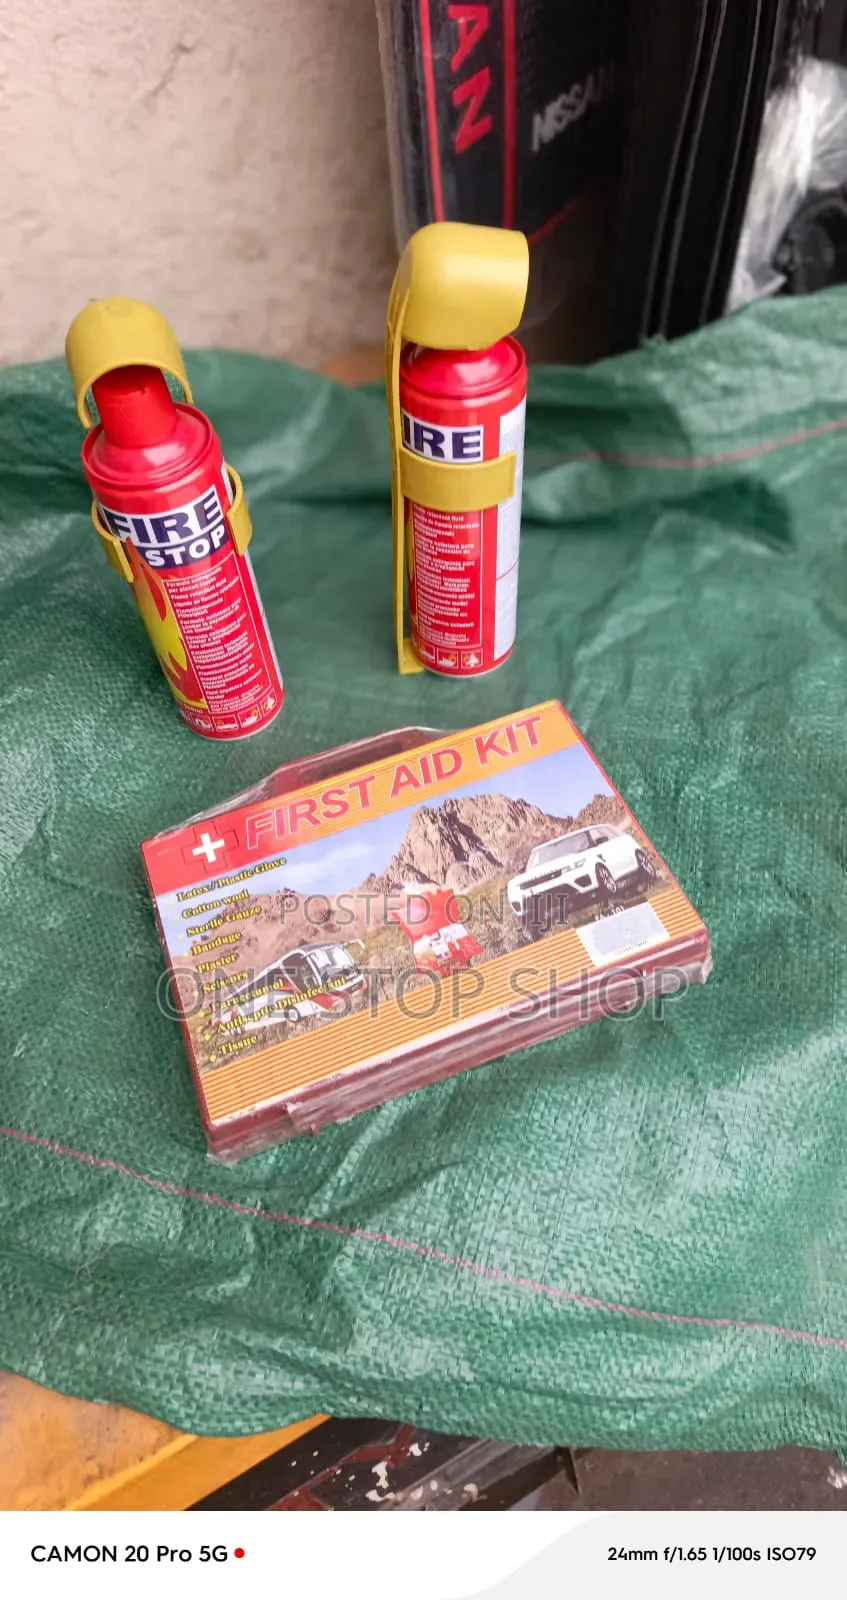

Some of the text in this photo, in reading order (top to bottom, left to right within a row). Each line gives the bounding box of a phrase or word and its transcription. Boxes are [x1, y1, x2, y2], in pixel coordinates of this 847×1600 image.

[102, 489, 222, 544] FIRE
[144, 524, 226, 568] STOP
[246, 714, 543, 850] FIRST AID KIT
[253, 856, 287, 875] Glove
[181, 889, 249, 919] Cotton wool
[190, 930, 242, 955] Bandage
[196, 953, 238, 975] Plaster
[219, 1035, 258, 1056] Tissue
